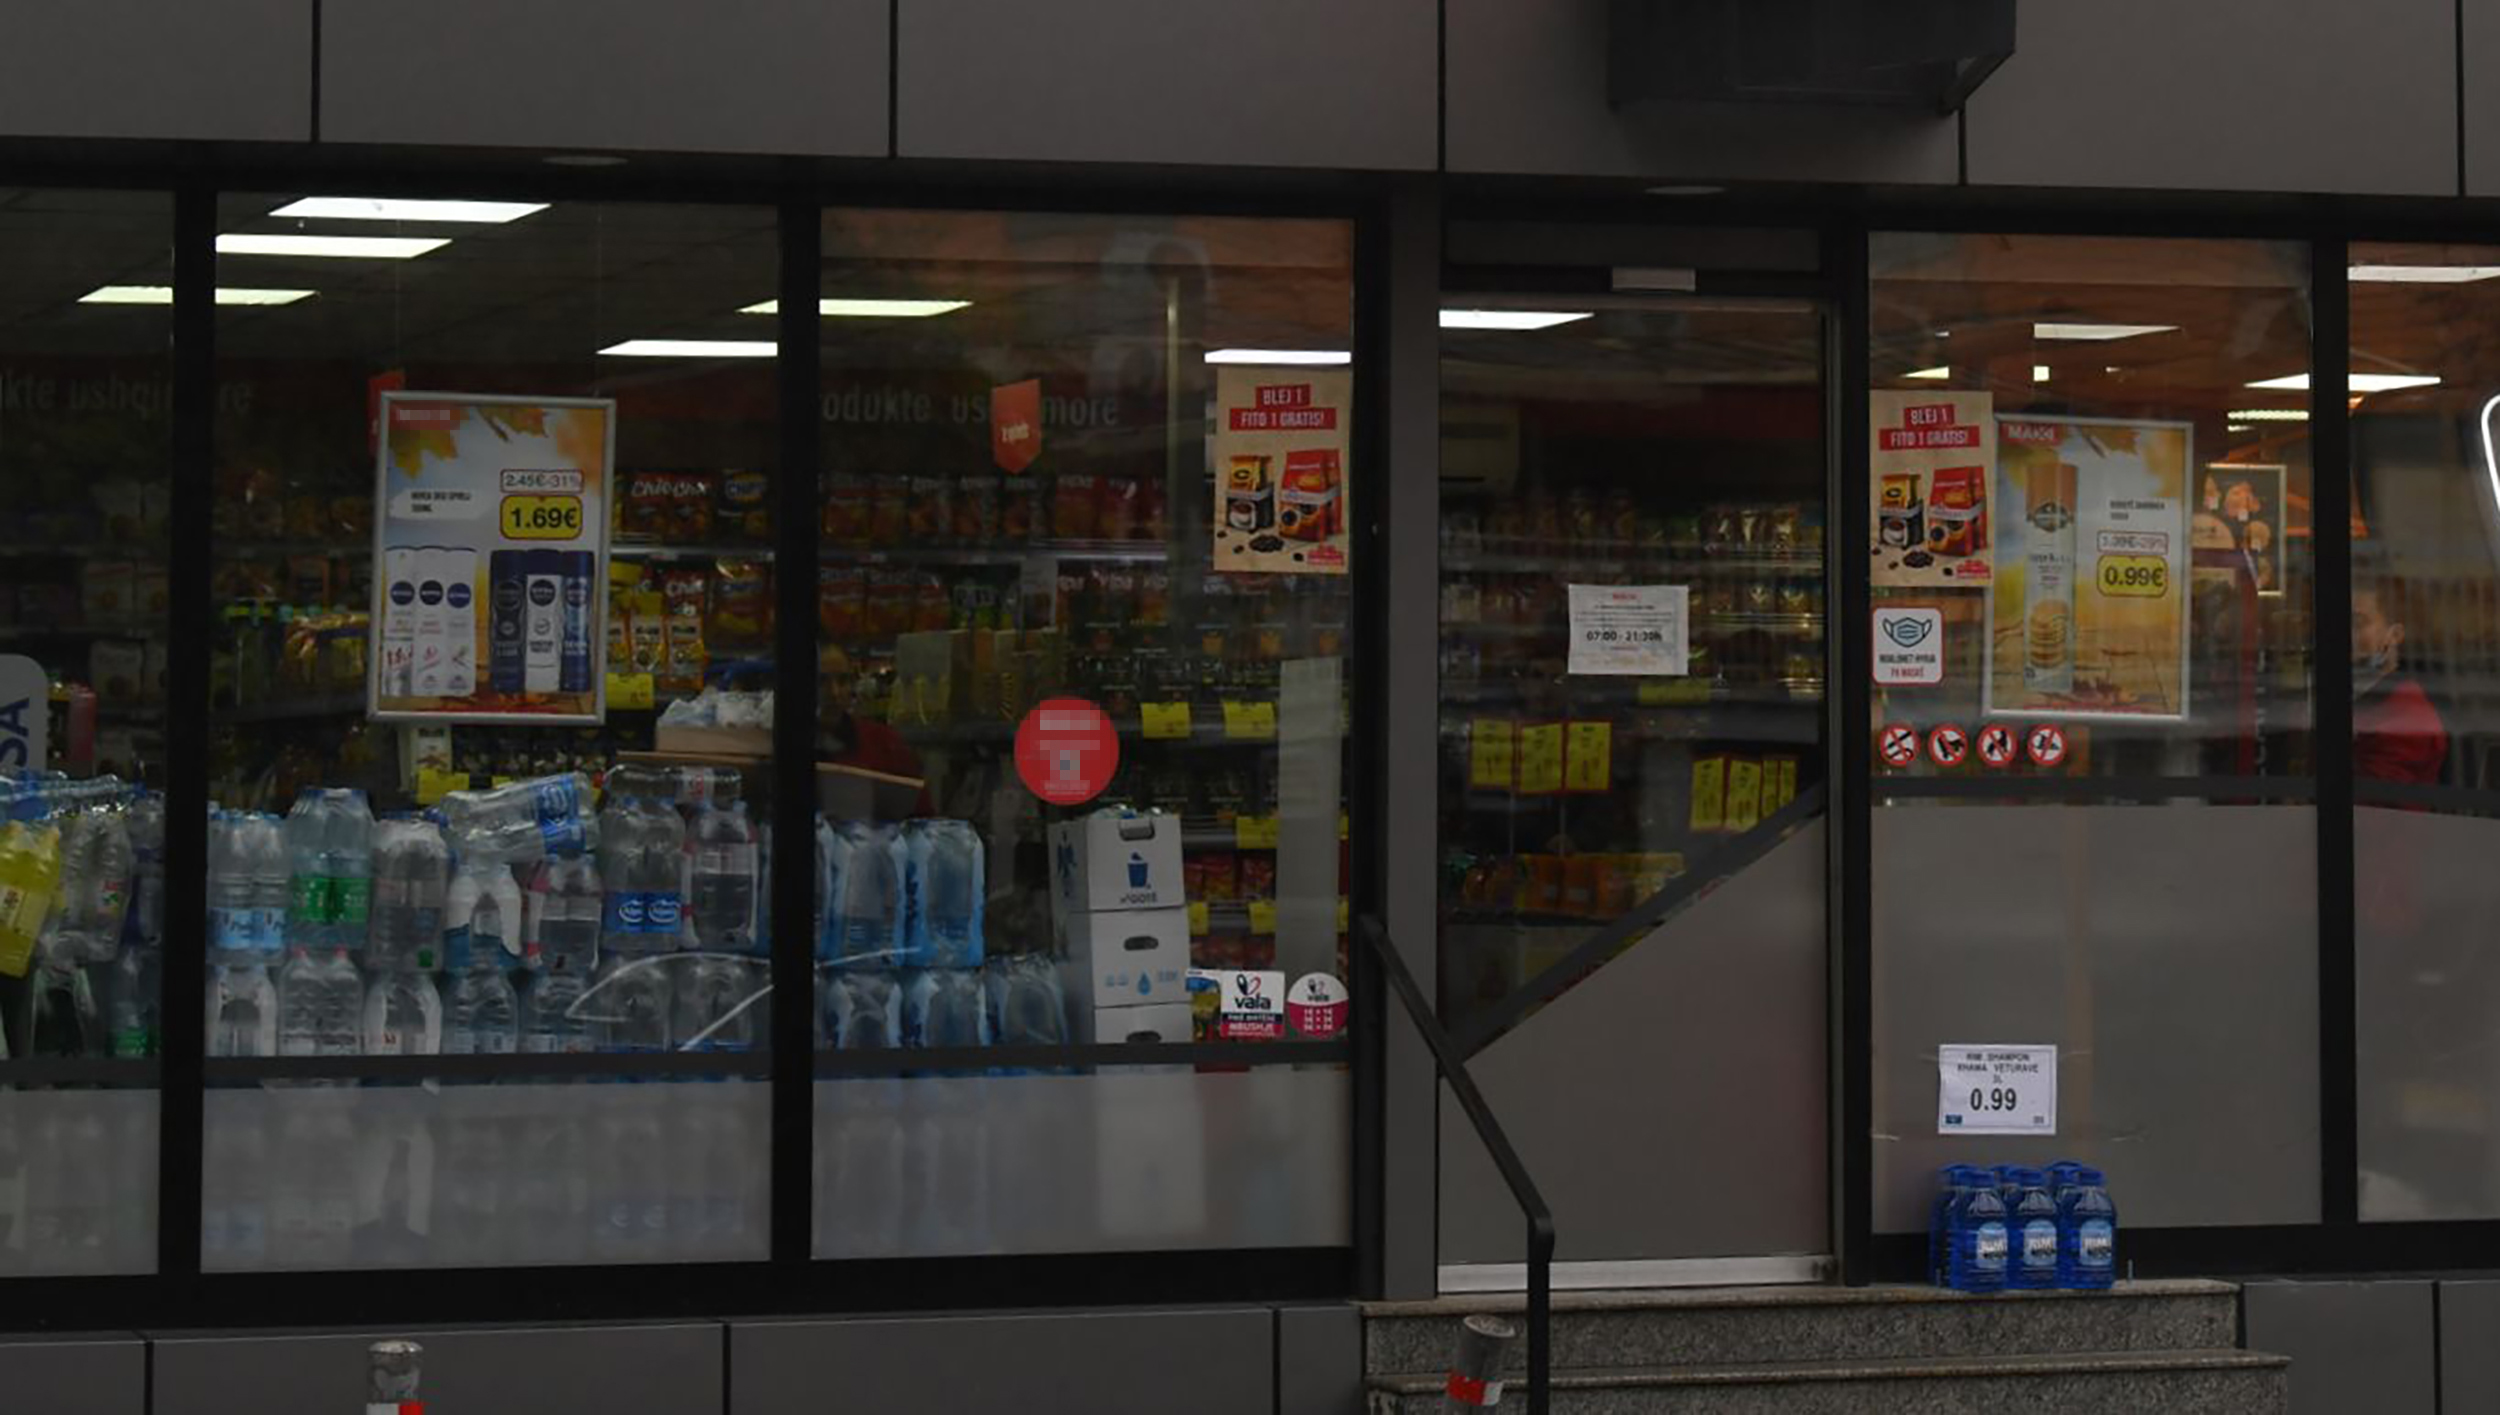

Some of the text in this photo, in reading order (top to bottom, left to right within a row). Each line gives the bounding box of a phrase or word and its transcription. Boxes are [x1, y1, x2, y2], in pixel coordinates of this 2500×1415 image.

[1262, 388, 1292, 406] BLEJ
[1910, 407, 1938, 425] BLEJ
[510, 507, 578, 529] 1.69€
[2104, 566, 2164, 588] 0.99€
[1234, 992, 1273, 1010] vala
[1970, 1087, 2017, 1111] 0.99
